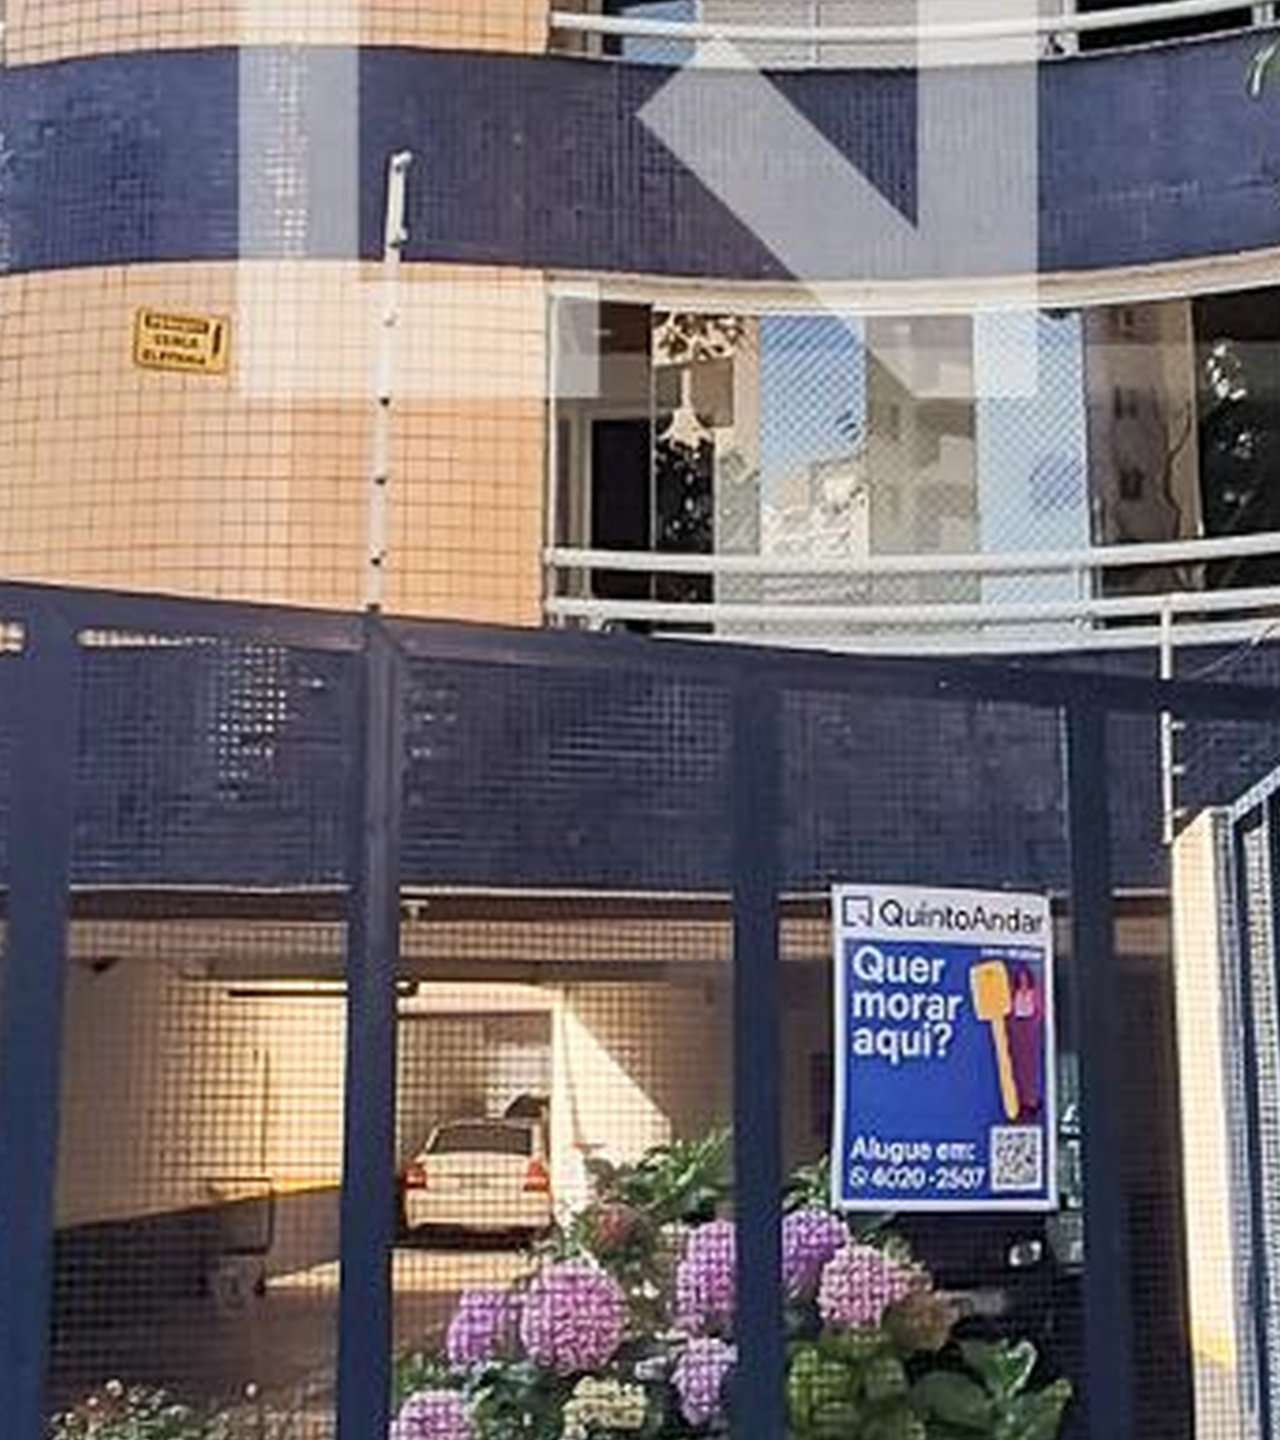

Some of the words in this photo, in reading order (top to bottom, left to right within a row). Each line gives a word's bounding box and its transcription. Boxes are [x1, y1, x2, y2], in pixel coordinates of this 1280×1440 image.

[879, 898, 1042, 934] QuintoAndar
[851, 944, 946, 984] Quer
[851, 992, 963, 1020] morar
[851, 1023, 953, 1065] aqui?
[849, 1135, 933, 1166] Alugue
[935, 1141, 977, 1162] em:
